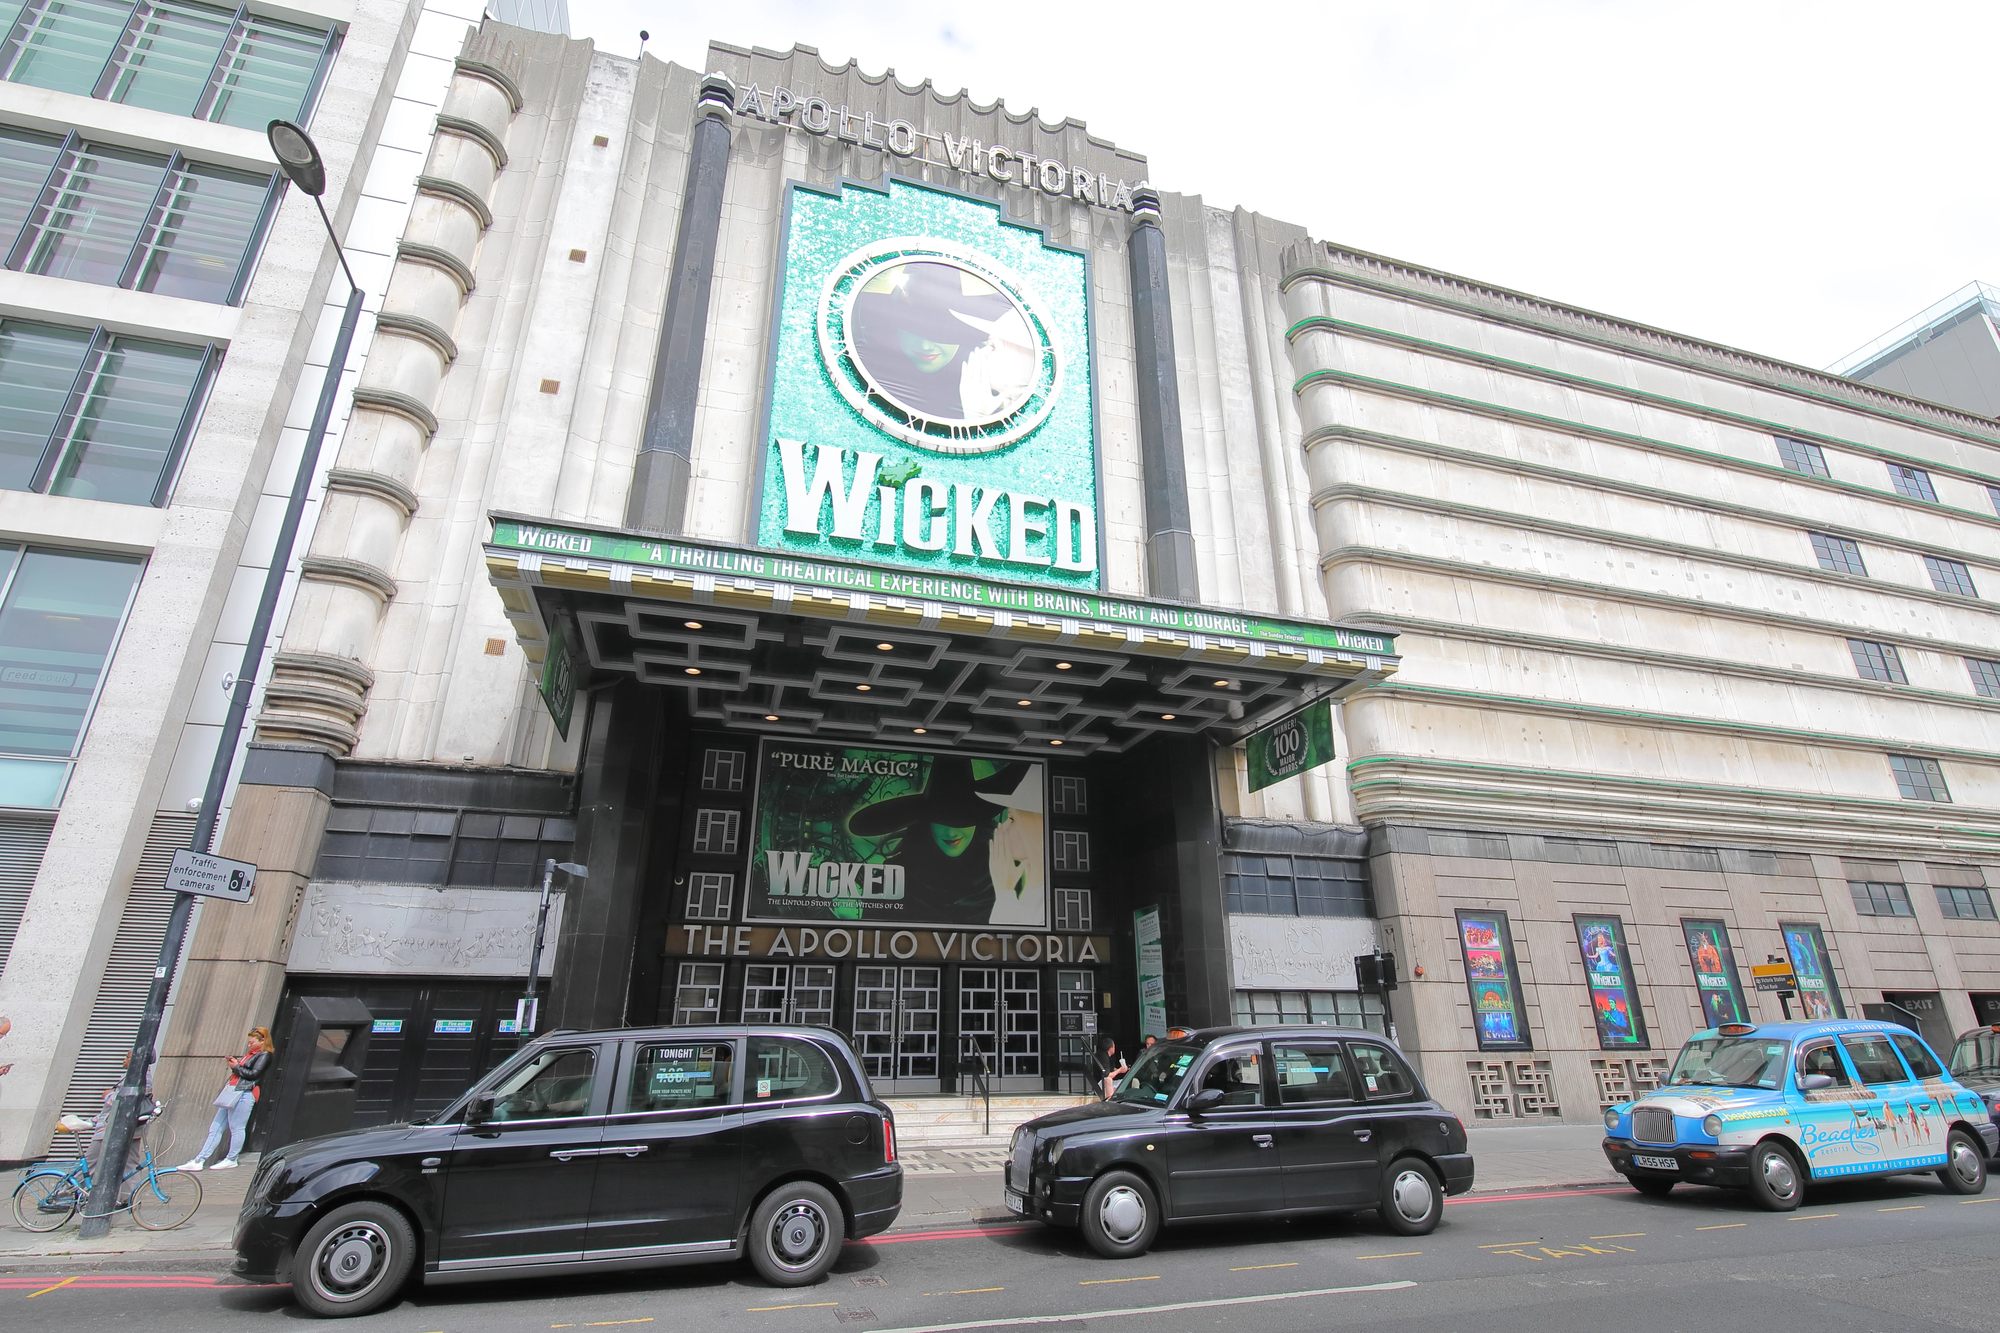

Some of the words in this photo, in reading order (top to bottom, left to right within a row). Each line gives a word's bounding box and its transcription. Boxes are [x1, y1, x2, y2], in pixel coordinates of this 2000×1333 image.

[739, 82, 916, 158] APOLLO
[943, 131, 1134, 213] VICTORIA
[775, 437, 1097, 573] WICKED
[516, 524, 591, 553] WICKED
[669, 546, 765, 574] THRILLING
[771, 558, 875, 588] THEATRICAL
[880, 572, 983, 602] EXPERIENCE
[987, 586, 1028, 607] WITH
[1033, 591, 1094, 618] BRAINS,
[1098, 600, 1146, 622] HEART
[1150, 607, 1179, 625] AND
[1334, 630, 1384, 651] WICKED
[1273, 717, 1297, 737] WINNER!
[1272, 728, 1300, 759] 100
[771, 751, 835, 771] “PURE
[840, 757, 918, 777] MAGIC.”
[1279, 753, 1296, 767] MAJOR
[1278, 761, 1299, 777] AWARDS
[191, 856, 218, 870] Traffic
[173, 866, 227, 882] enforcement
[765, 850, 905, 900] WICKED
[179, 878, 215, 892] cameras
[782, 899, 810, 907] UNTOLD
[811, 899, 831, 907] STORY
[683, 925, 752, 956] THE
[767, 927, 918, 959] APOLLO
[932, 932, 1100, 963] VICTORIA
[1590, 973, 1622, 986] WICKED
[1698, 974, 1728, 987] WICKED
[1904, 999, 1933, 1010] EXIT
[1817, 1025, 1849, 1033] JAMAICA
[660, 1048, 694, 1059] TONIGHT
[1722, 1106, 1790, 1122] beaches.co.uk
[1799, 1117, 1878, 1146] Beaches
[1820, 1145, 1849, 1156] Resorts
[1637, 1156, 1658, 1167] LR55
[1658, 1158, 1676, 1168] HSF
[1817, 1164, 1869, 1176] CARIBBEAN
[1872, 1161, 1902, 1171] FAMILY
[1906, 1156, 1942, 1166] RESORTS
[1492, 1243, 1636, 1261] TAXI
